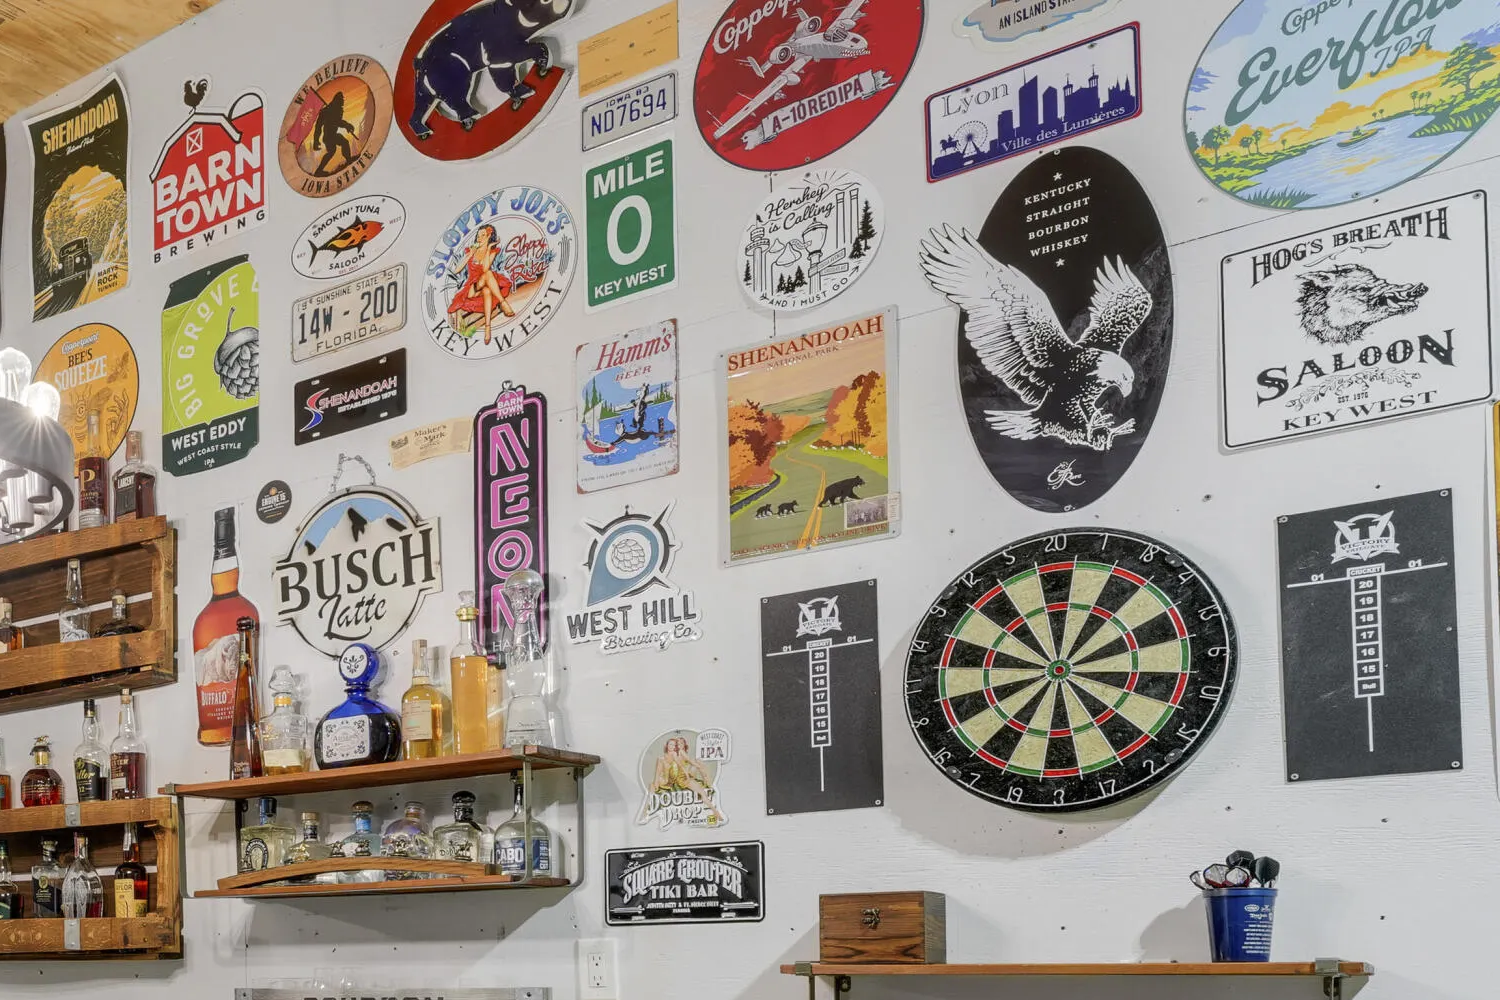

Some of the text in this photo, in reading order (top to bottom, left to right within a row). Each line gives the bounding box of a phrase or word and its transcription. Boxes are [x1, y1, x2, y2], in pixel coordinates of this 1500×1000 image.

[999, 16, 1011, 30] AN
[1013, 2, 1047, 24] ISLAND
[314, 58, 370, 86] BELIEVE
[605, 92, 631, 108] IOWA
[771, 79, 864, 133] A-10 RED IPA
[940, 82, 1011, 118] Lyon
[42, 93, 119, 155] SHENANDOAH
[1002, 127, 1058, 152] Ville des
[156, 135, 261, 211] BARN
[301, 150, 376, 195] IOWA STATE
[593, 150, 665, 200] MILE
[764, 186, 827, 220] Hershey
[1024, 177, 1093, 206] KENTUCKY
[156, 172, 262, 242] TOWN
[354, 204, 381, 216] TUNA
[768, 201, 836, 235] is Calling
[1026, 196, 1091, 223] STRAIGHT
[153, 210, 266, 264] BREWING
[426, 186, 571, 280] SLOPPY JOE'S
[606, 194, 653, 266] 0
[1028, 216, 1090, 240] BOURBON
[1030, 233, 1089, 257] WHISKEY
[1250, 206, 1452, 289] HOG'S BREATH
[328, 251, 366, 271] SALOON
[97, 272, 119, 287] ROCK
[315, 276, 379, 307] SUNSHINE STATE
[594, 263, 668, 300] KEY WEST
[767, 277, 849, 308] AND MUST GO
[297, 280, 399, 345] 14W 200
[430, 279, 563, 357] KEY WEST
[175, 273, 241, 420] BIG GROVE
[315, 323, 378, 353] FLORIDA
[595, 327, 673, 372] Hamm's
[727, 313, 885, 372] SHENANDOAH
[67, 347, 93, 369] BEE'S
[766, 344, 840, 369] NATIONAL PARK
[1255, 327, 1459, 408] SALOON
[54, 354, 108, 393] SQUEEZE
[615, 365, 652, 382] BEER
[317, 375, 398, 411] SHENANDOAH
[1283, 389, 1438, 432] KEY WEST
[171, 416, 248, 453] WEST EDDY
[176, 441, 243, 467] WEST COAST STYLE
[1043, 533, 1068, 553] 20
[1138, 543, 1161, 563] 18
[275, 527, 436, 616] BUSCH
[958, 570, 983, 589] 12
[1358, 579, 1374, 590] 20
[1358, 595, 1375, 606] 19
[567, 594, 697, 640] WEST HILL
[1359, 612, 1375, 623] 18
[603, 631, 670, 650] Brewing
[1359, 629, 1375, 640] 17
[1360, 646, 1376, 657] 16
[1361, 664, 1377, 674] 15
[700, 746, 725, 759] IPA
[1052, 788, 1067, 806] 3
[1097, 778, 1118, 799] 17
[660, 805, 704, 828] DROP
[495, 846, 525, 866] CABO
[622, 857, 744, 904] SQUARE GROUPER
[649, 883, 720, 900] TIKI BAR
